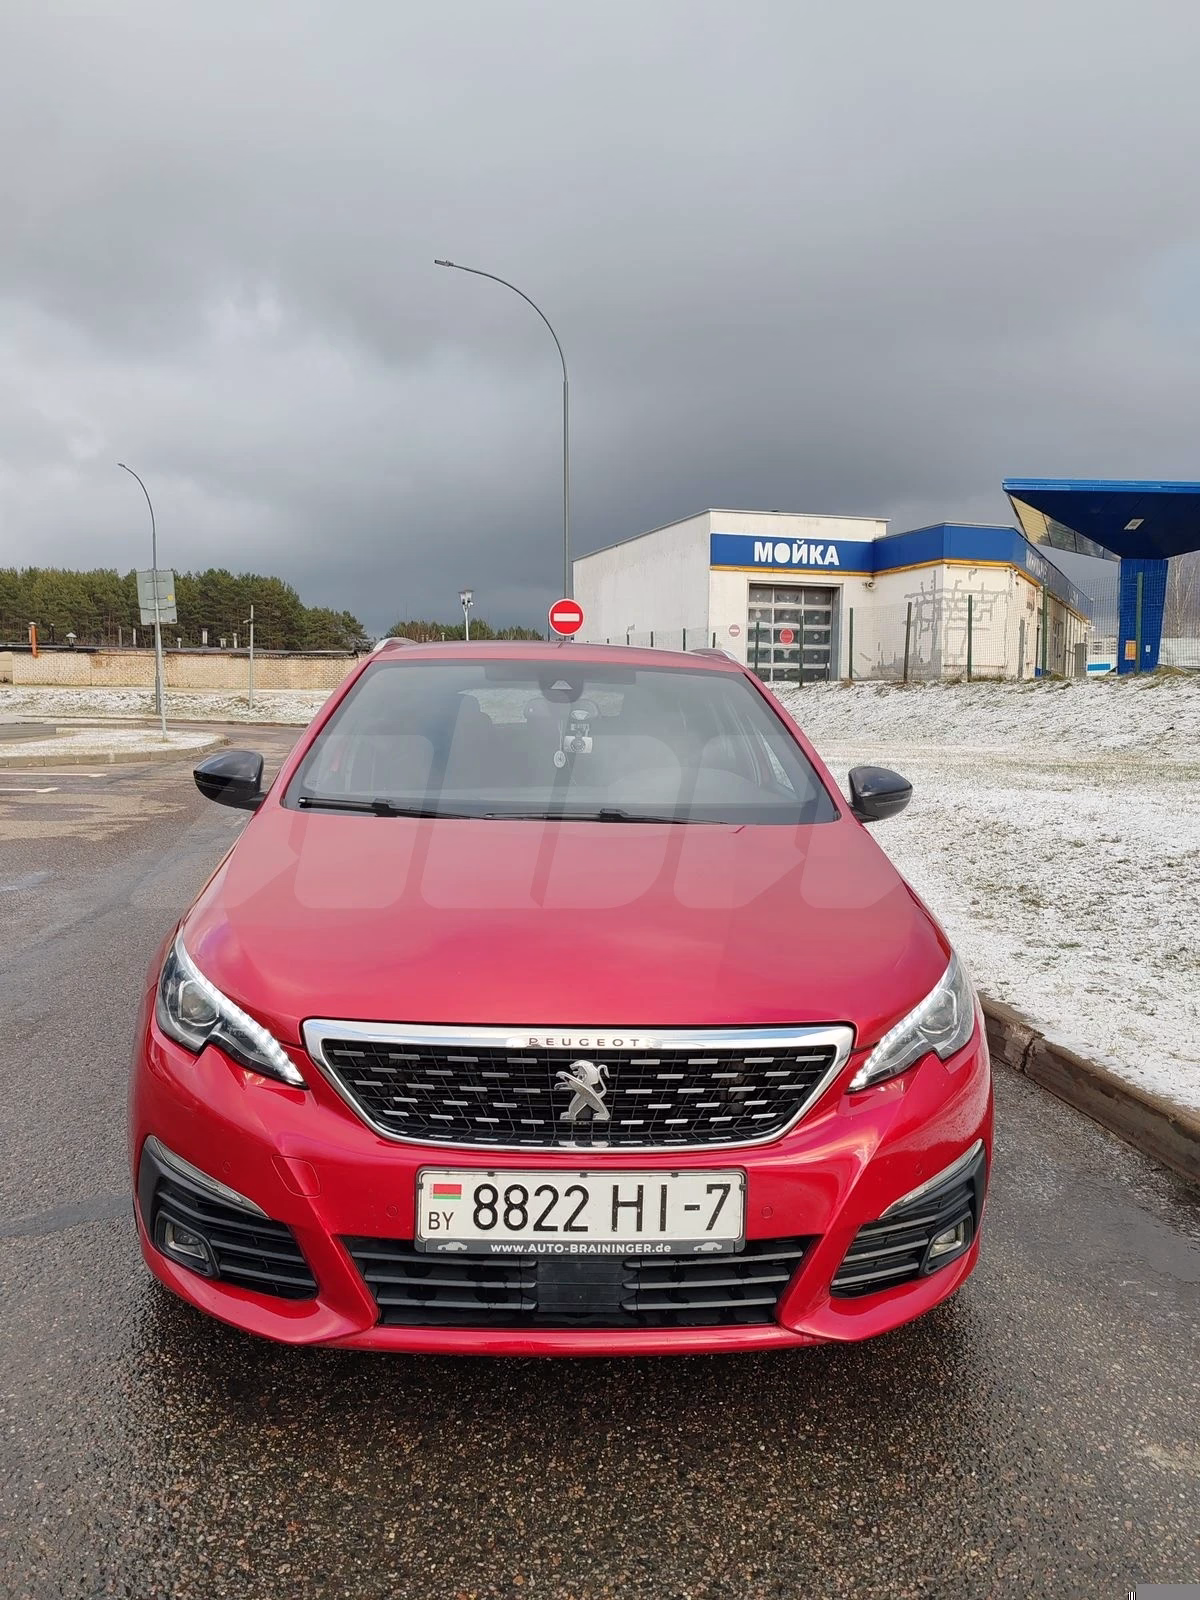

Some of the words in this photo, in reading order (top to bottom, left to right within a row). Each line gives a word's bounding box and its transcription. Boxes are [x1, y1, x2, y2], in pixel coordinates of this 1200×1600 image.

[754, 539, 840, 566] МОЙКА
[528, 1036, 641, 1047] PEUGEOT
[472, 1183, 590, 1232] 8822
[427, 1211, 455, 1231] BY
[490, 1242, 672, 1254] www.AUTO-BRAININGER.de
